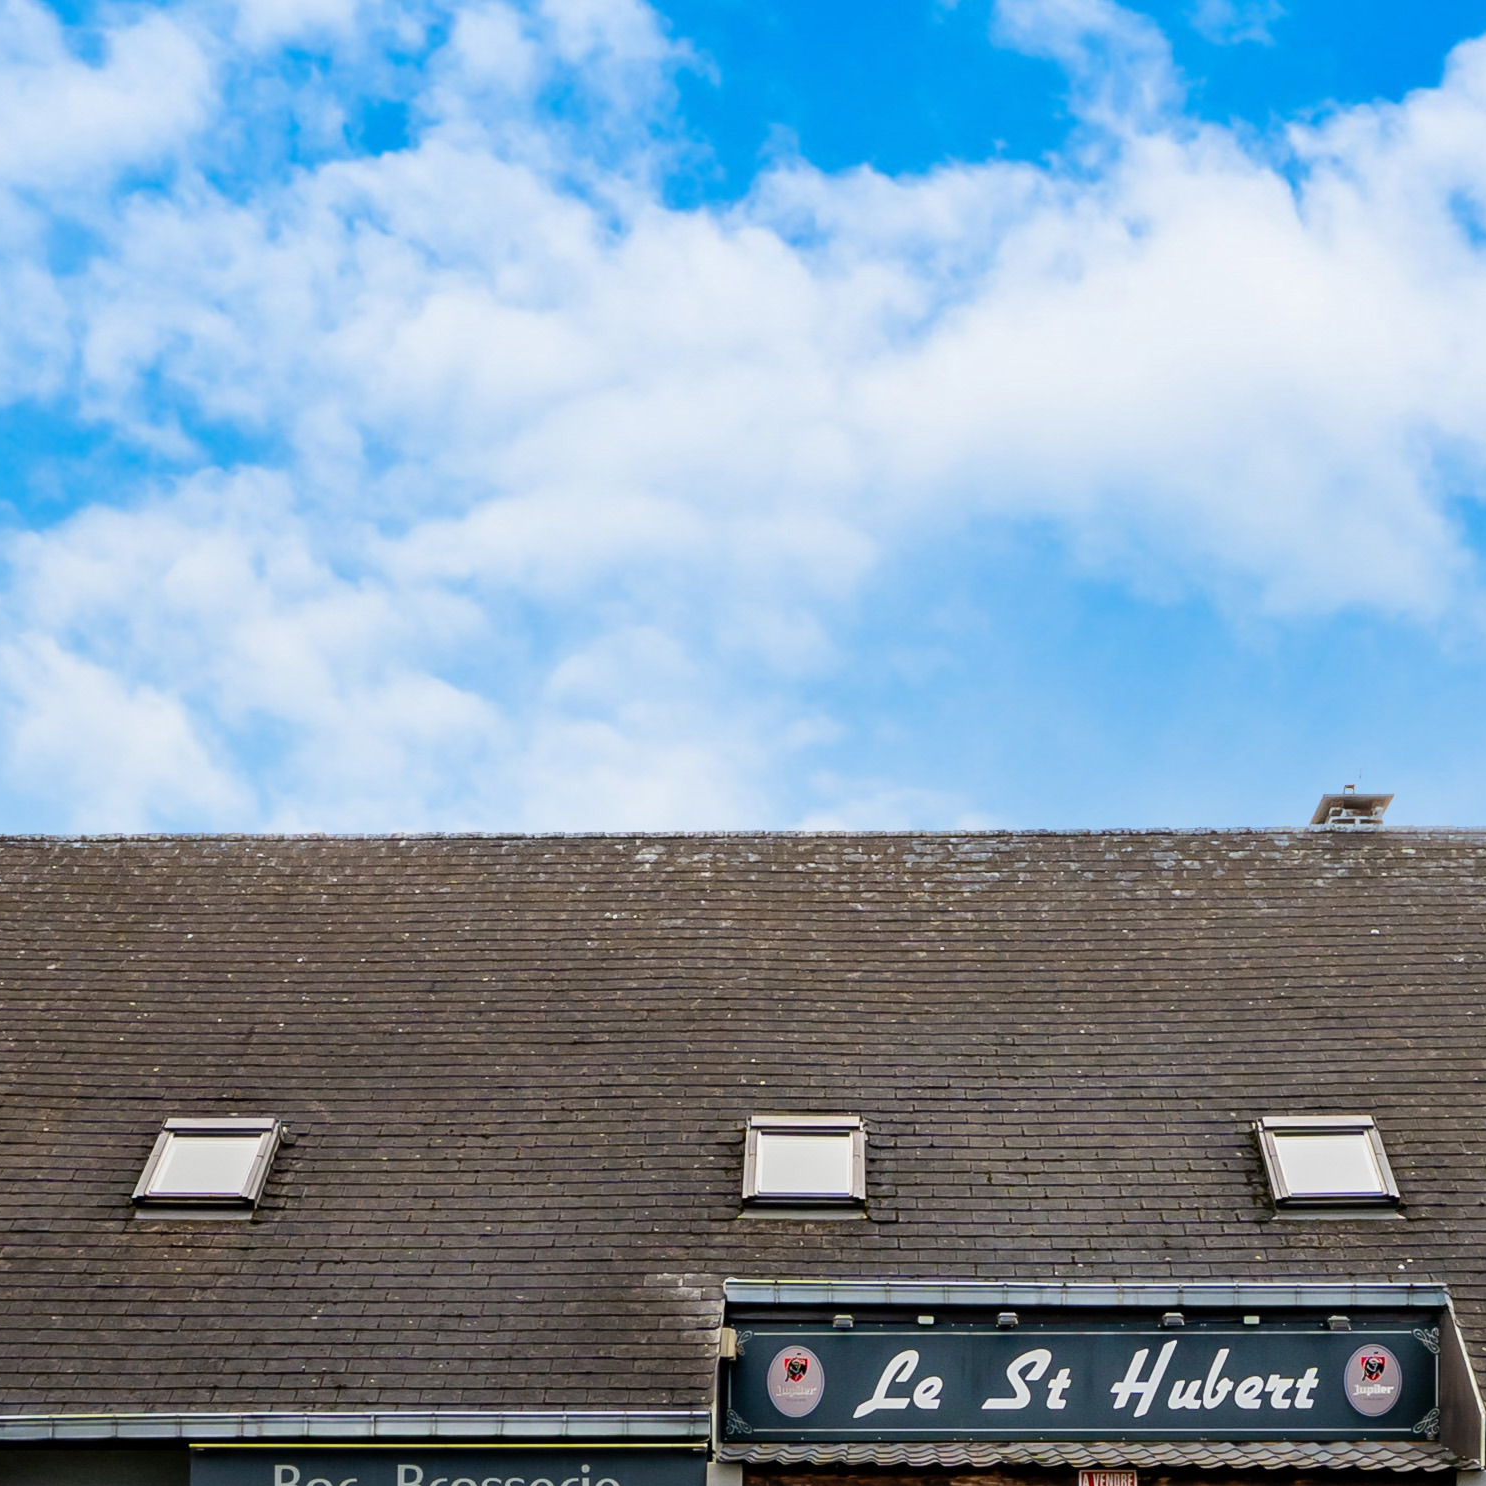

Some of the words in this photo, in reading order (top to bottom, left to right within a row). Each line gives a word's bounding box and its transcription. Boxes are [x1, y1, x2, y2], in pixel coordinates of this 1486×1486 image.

[852, 1350, 944, 1418] Le
[981, 1348, 1073, 1410] St
[1109, 1340, 1320, 1418] Hubert
[1353, 1383, 1395, 1396] Jupiler
